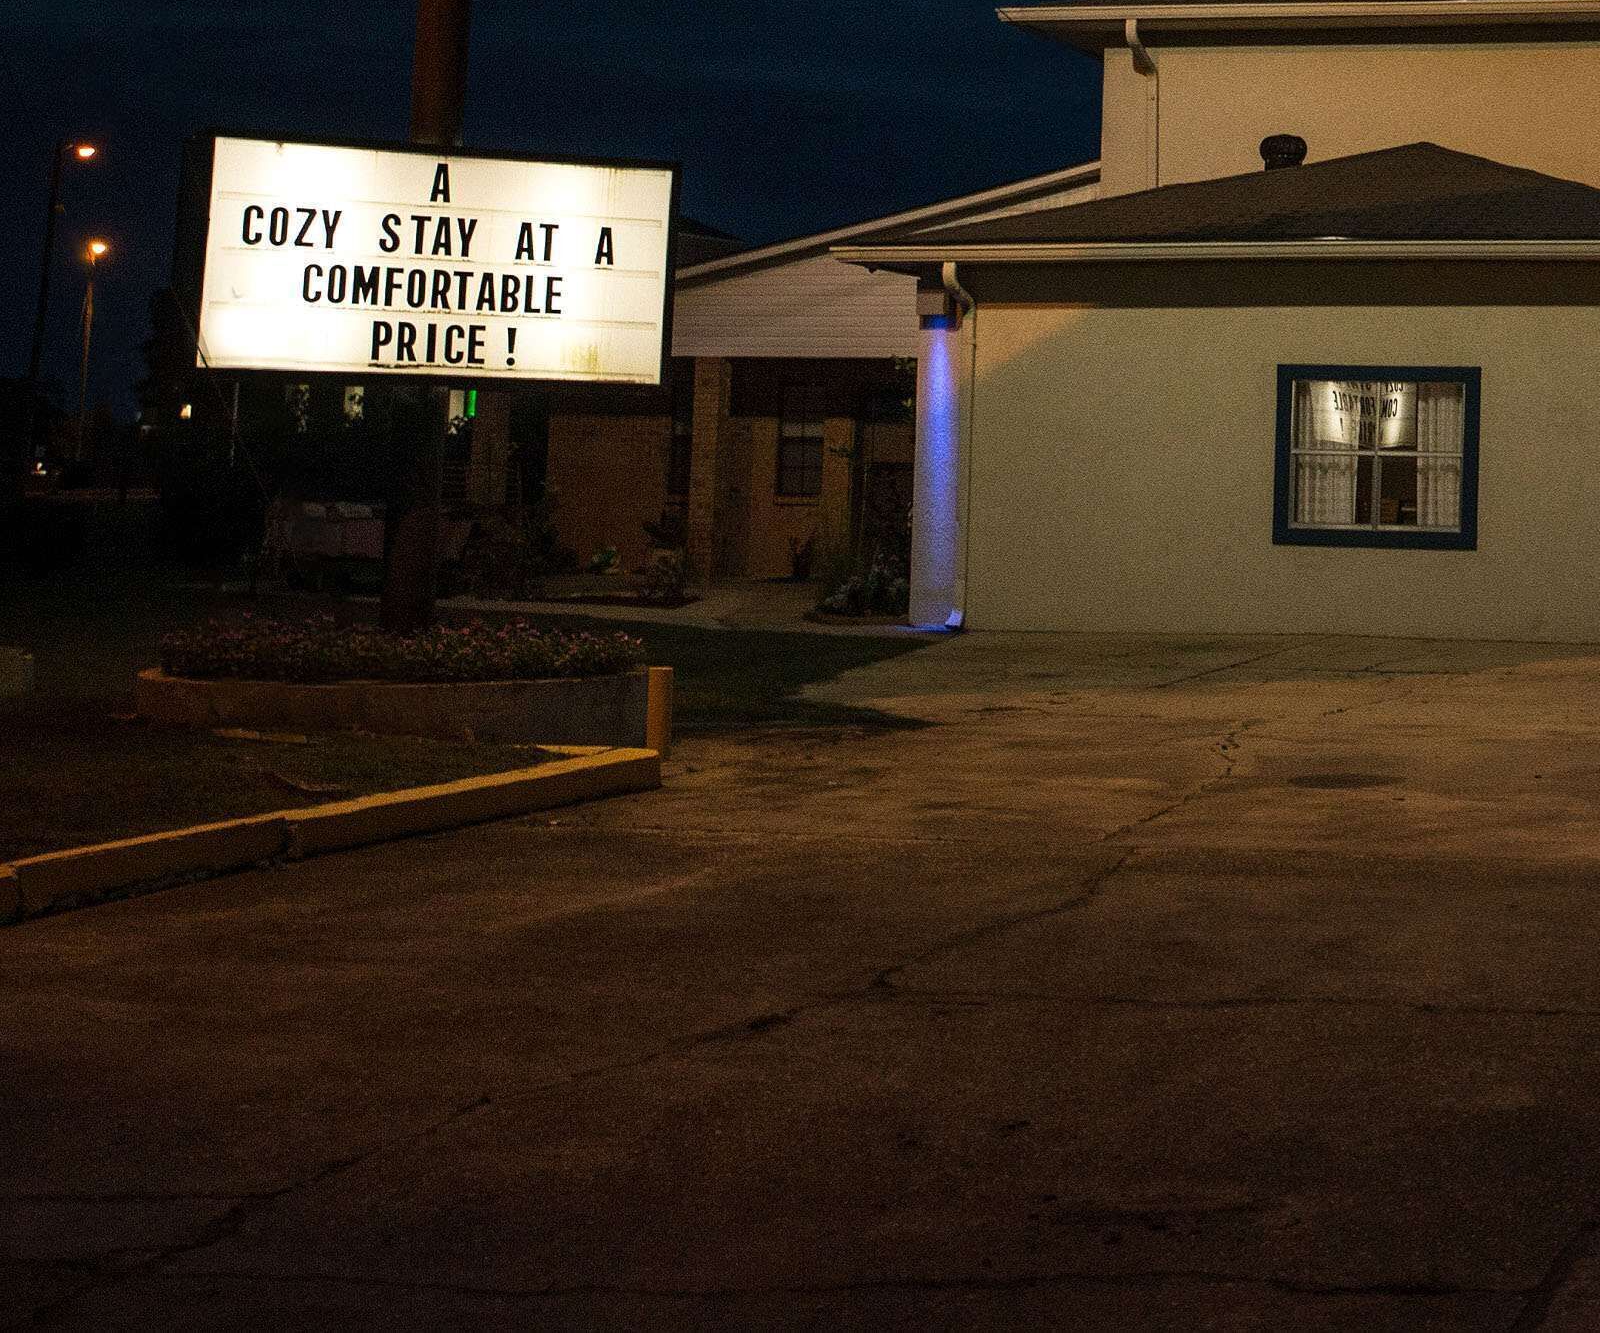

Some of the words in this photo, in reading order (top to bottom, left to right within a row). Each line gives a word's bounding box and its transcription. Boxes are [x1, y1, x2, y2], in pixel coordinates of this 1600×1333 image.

[429, 162, 451, 203] A
[242, 205, 342, 249] COZY
[378, 213, 478, 258] STAY
[514, 221, 560, 262] AT
[594, 226, 615, 266] A
[302, 263, 563, 315] COMFORTABLE
